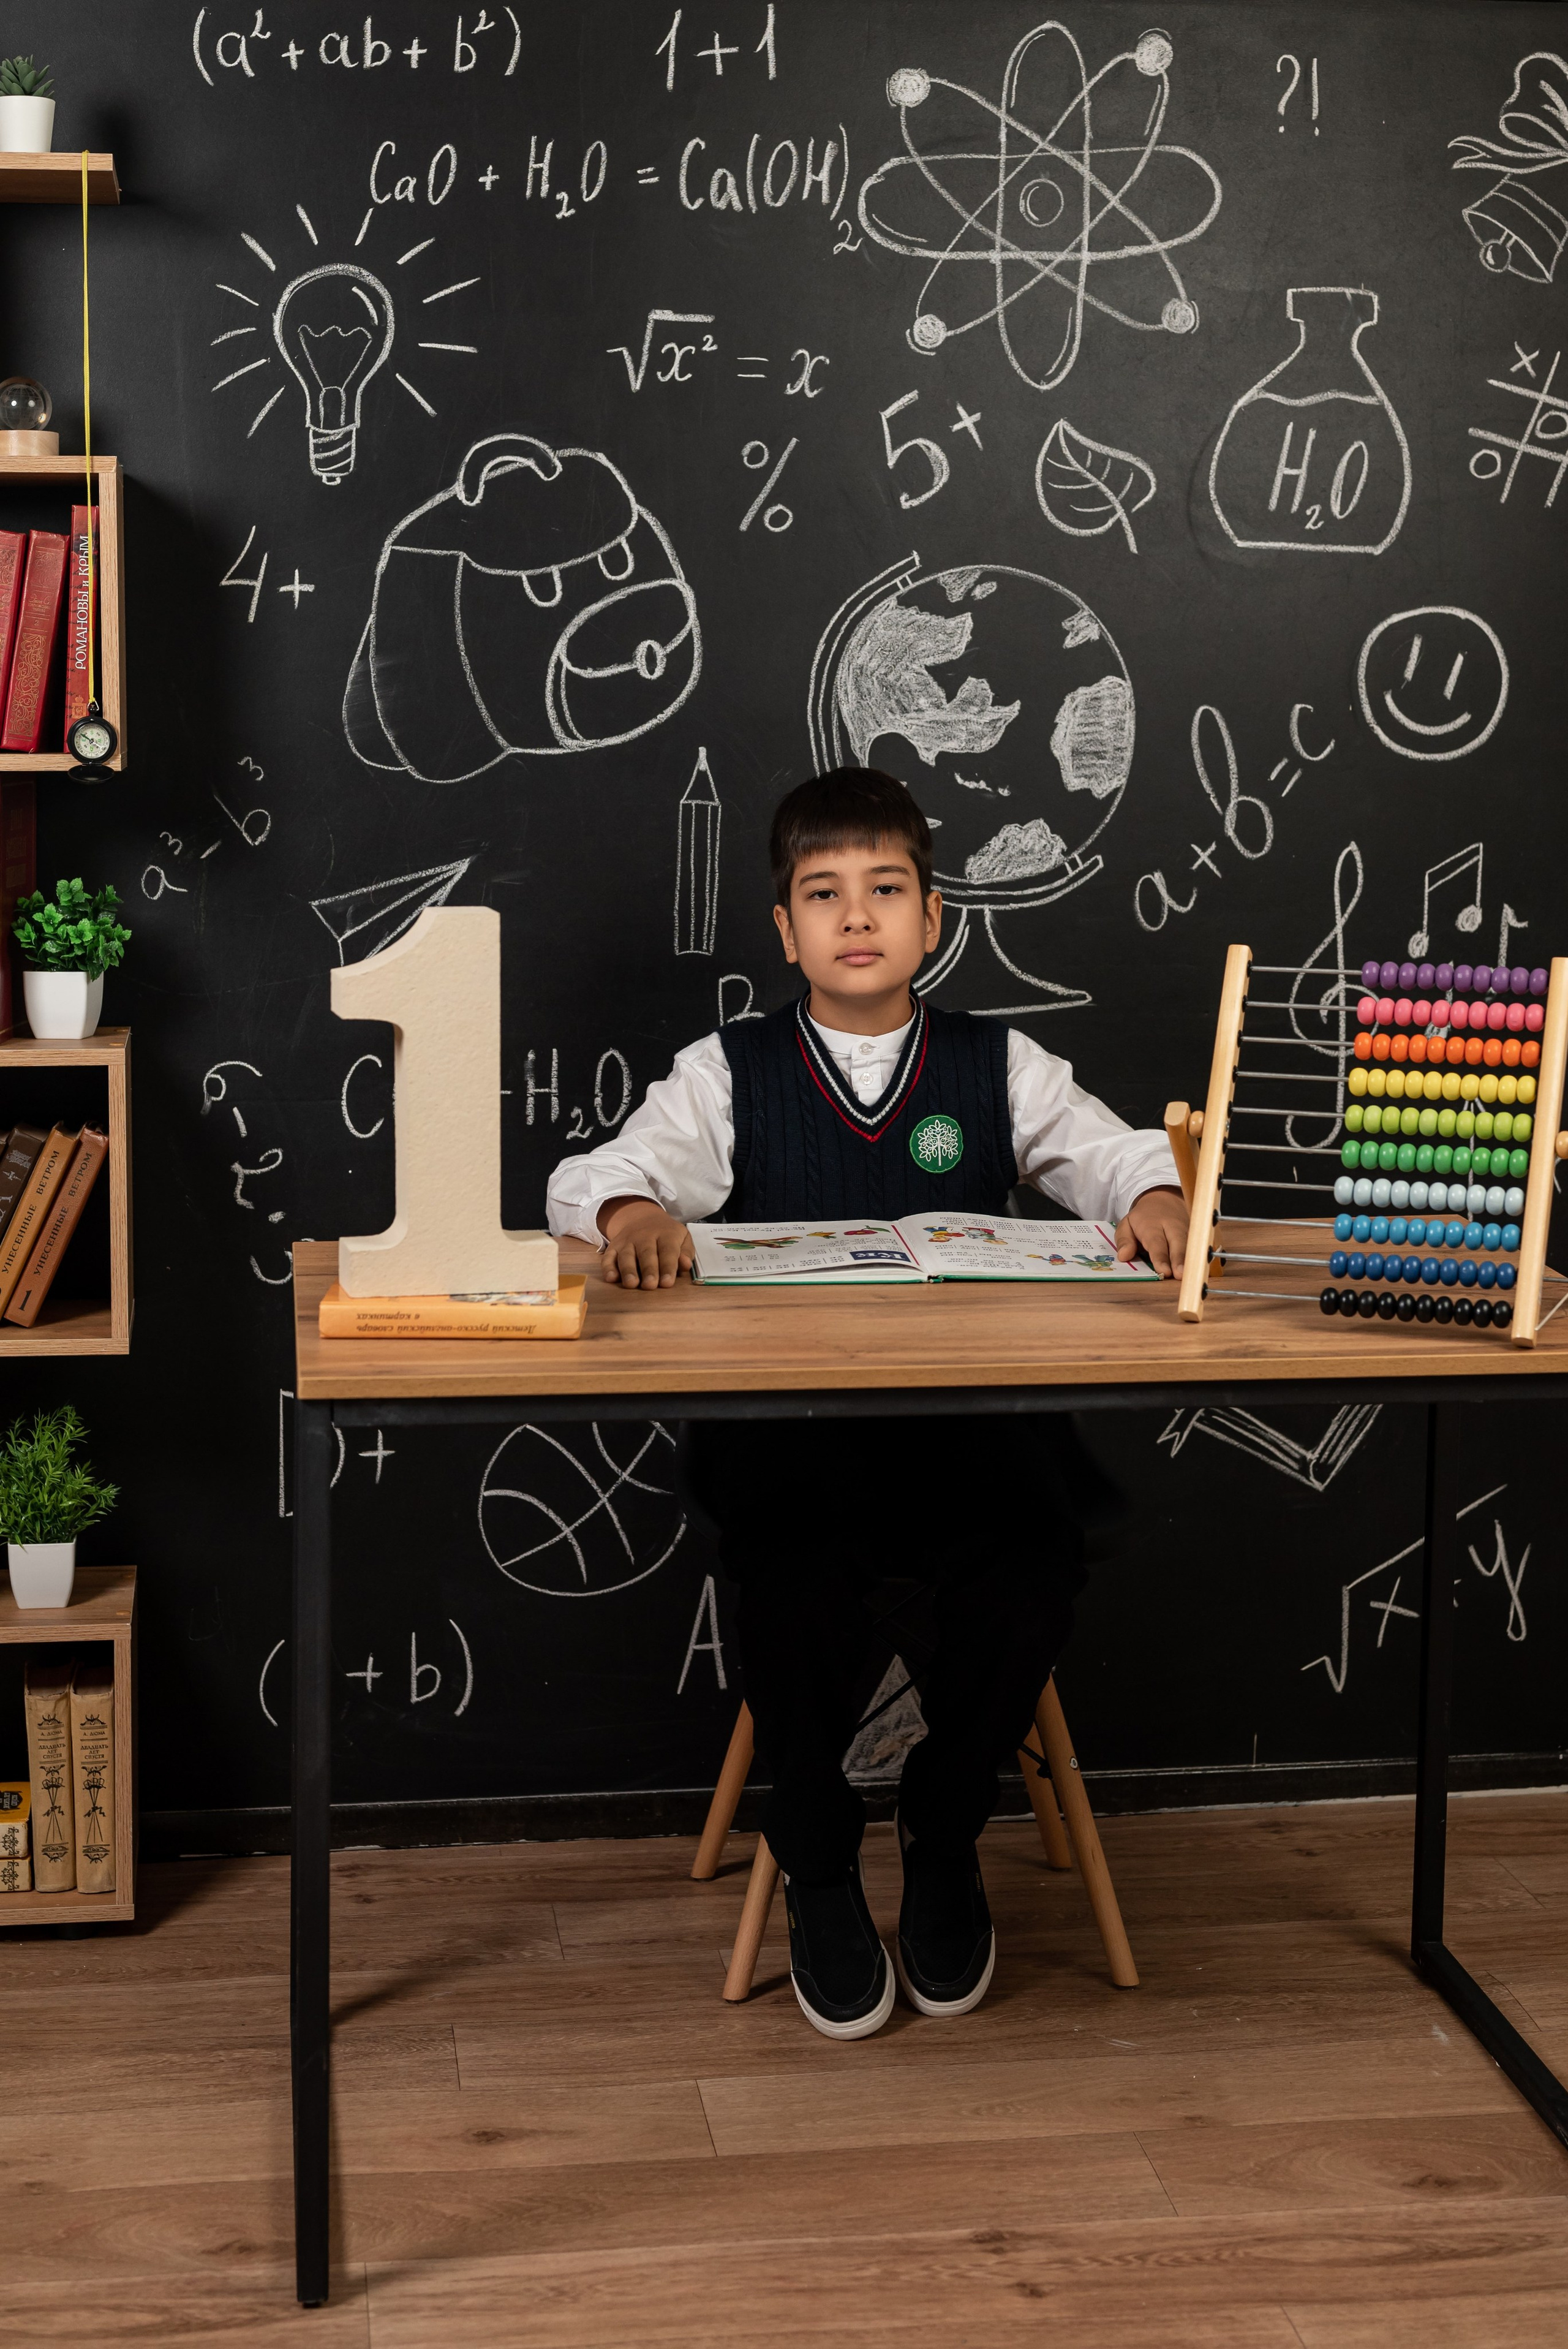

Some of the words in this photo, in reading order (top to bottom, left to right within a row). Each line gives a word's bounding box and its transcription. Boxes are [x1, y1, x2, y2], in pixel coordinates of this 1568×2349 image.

[1277, 55, 1319, 136] ?!
[370, 141, 457, 205] CaO
[739, 437, 799, 532] %
[79, 535, 91, 576] КРЫМ
[75, 591, 89, 670] РОМАНОВЫ
[331, 906, 559, 1298] 1
[1, 1204, 37, 1274] УНЕСЕННЫЕ
[36, 1150, 60, 1195] ВЕТРОМ
[34, 1206, 69, 1276] УНЕСЕННЫЕ
[67, 1152, 92, 1197] ВЕТРОМ
[18, 1289, 32, 1311] 1
[356, 1312, 411, 1320] картинках
[356, 1324, 394, 1333] словарь
[398, 1323, 489, 1334] русско-английский
[492, 1324, 537, 1334] Детский
[677, 1574, 727, 1694] A
